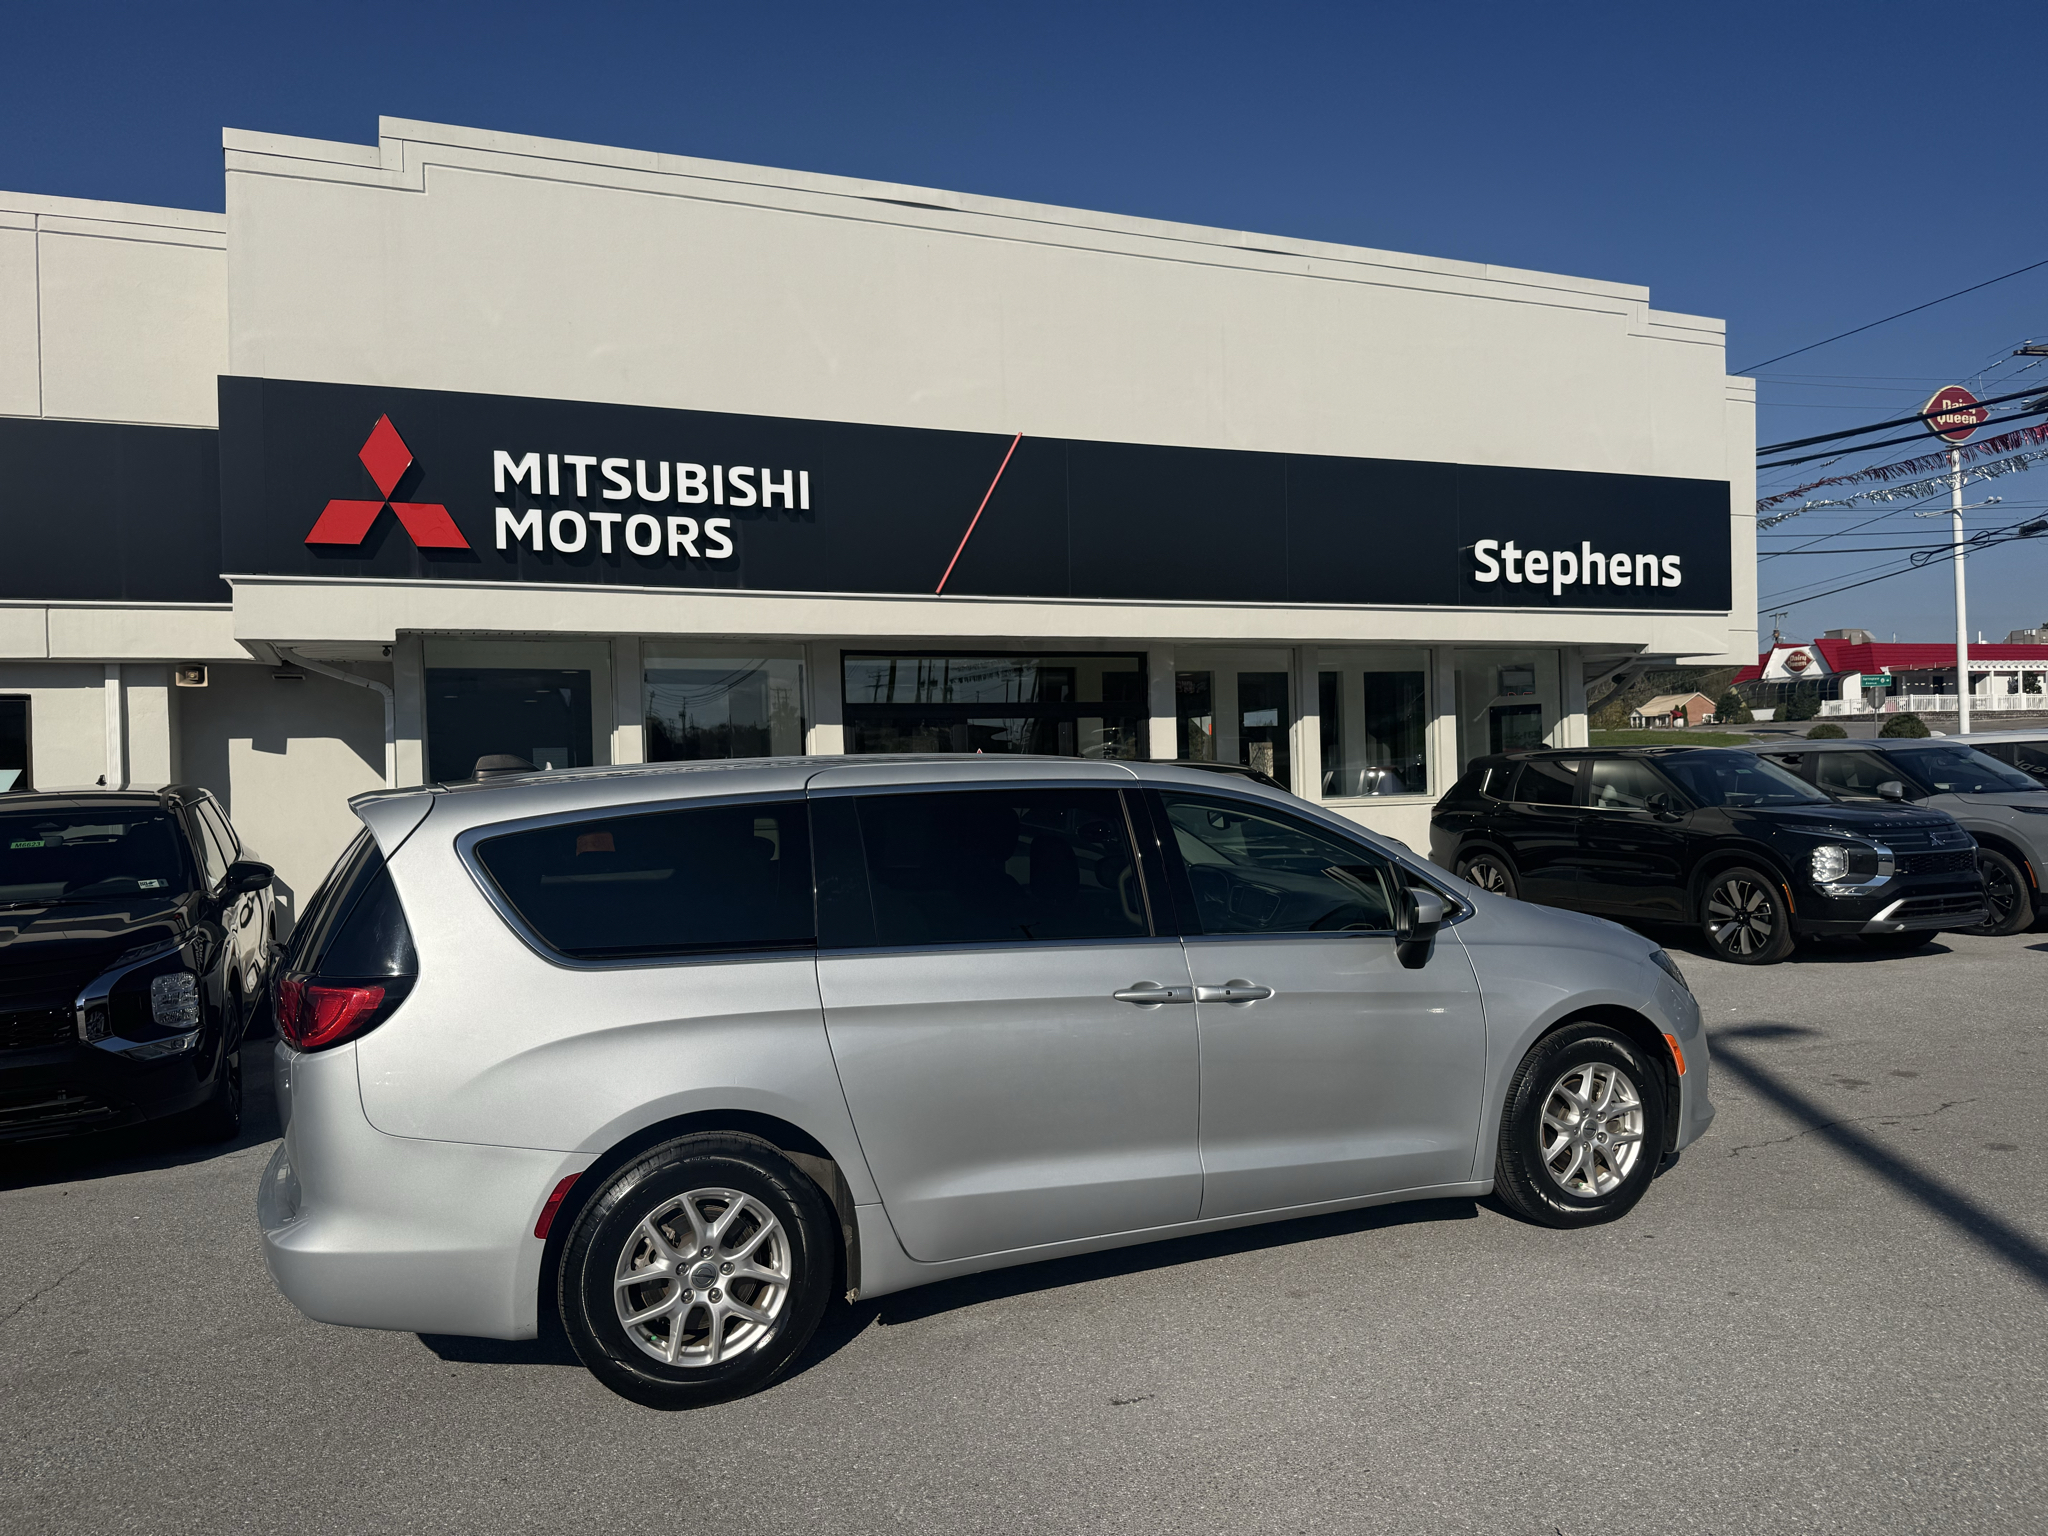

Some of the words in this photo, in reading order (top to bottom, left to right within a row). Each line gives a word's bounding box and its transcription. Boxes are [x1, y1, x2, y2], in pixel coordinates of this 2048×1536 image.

[1936, 413, 1977, 425] Queen
[493, 450, 810, 510] MITSUBISHI
[495, 507, 734, 559] MOTORS
[1474, 539, 1682, 596] Stephens
[1789, 654, 1807, 662] Dairy
